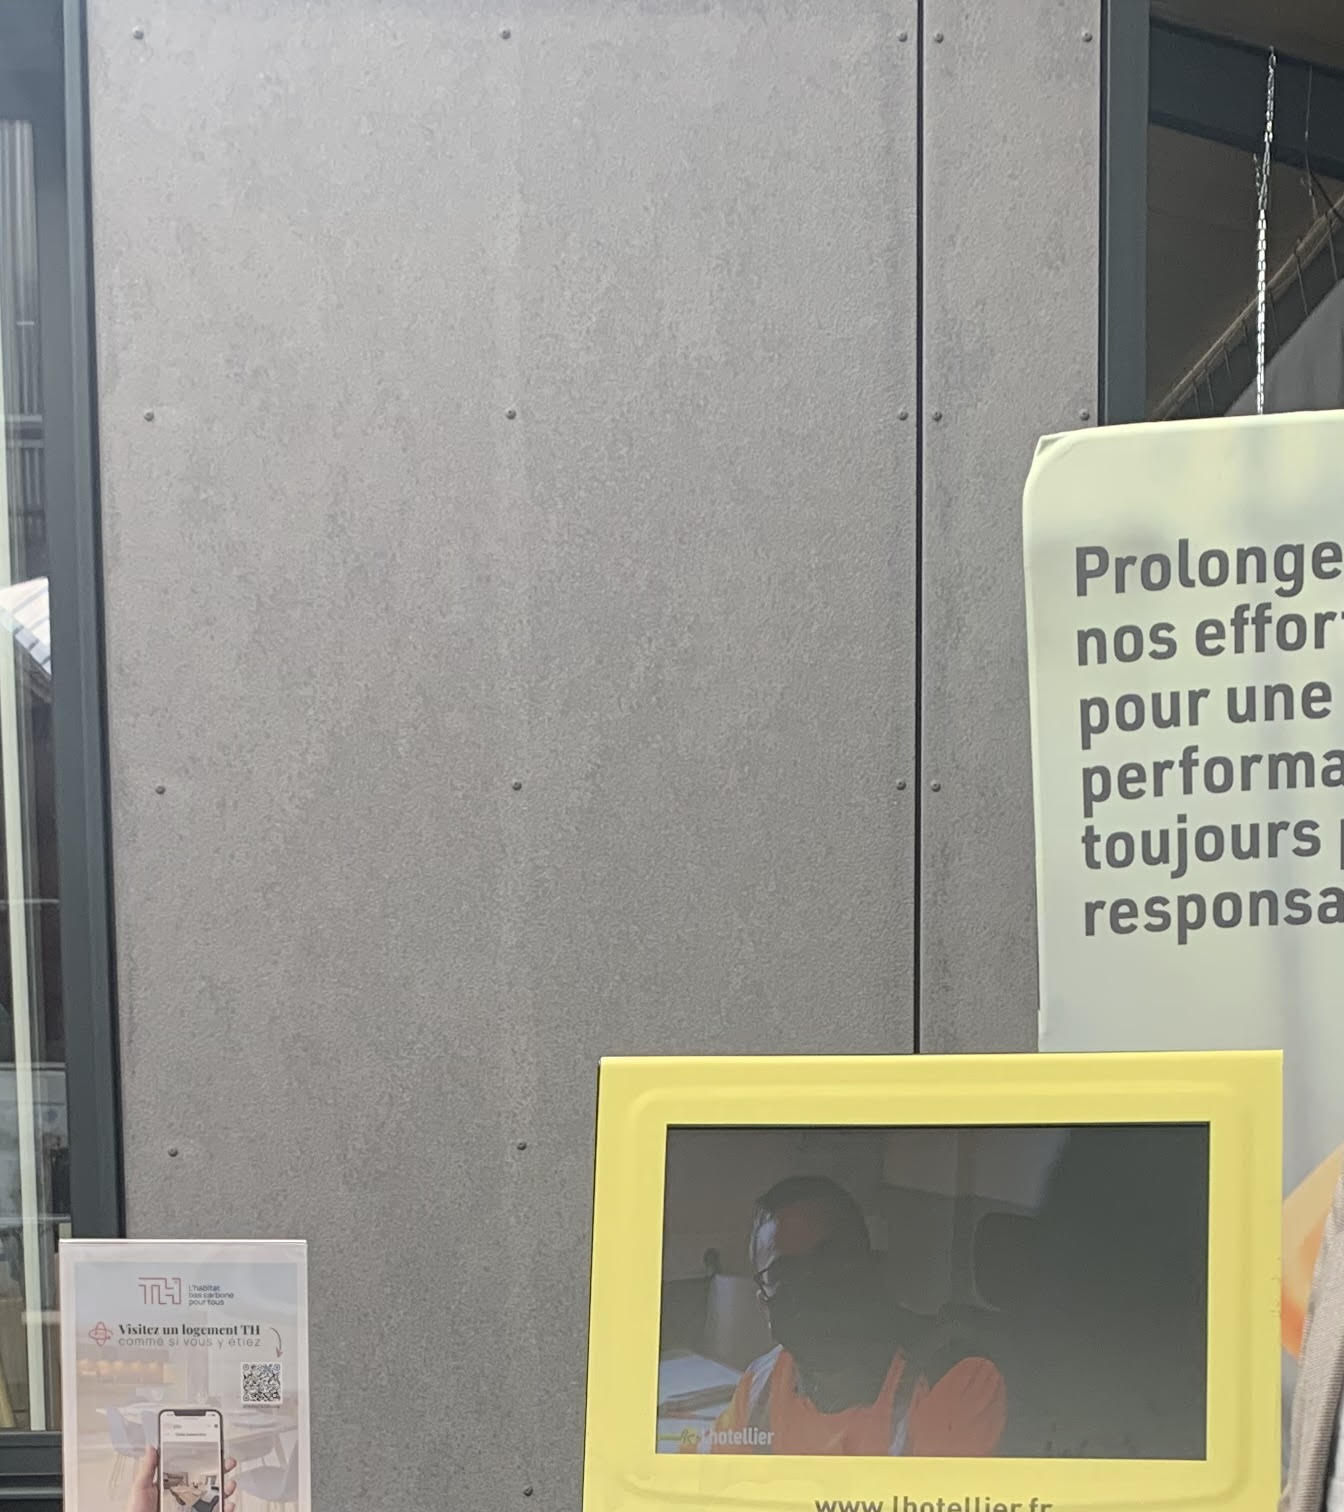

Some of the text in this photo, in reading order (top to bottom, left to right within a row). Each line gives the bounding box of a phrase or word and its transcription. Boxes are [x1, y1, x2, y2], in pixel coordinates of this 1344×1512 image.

[1076, 624, 1178, 667] nos
[1079, 680, 1333, 750] pour une
[1080, 813, 1322, 880] toujours
[118, 1323, 261, 1338] Visitez un logement TH
[118, 1338, 165, 1348] comme
[168, 1336, 179, 1348] si
[183, 1338, 213, 1348] vous
[217, 1339, 224, 1350] y
